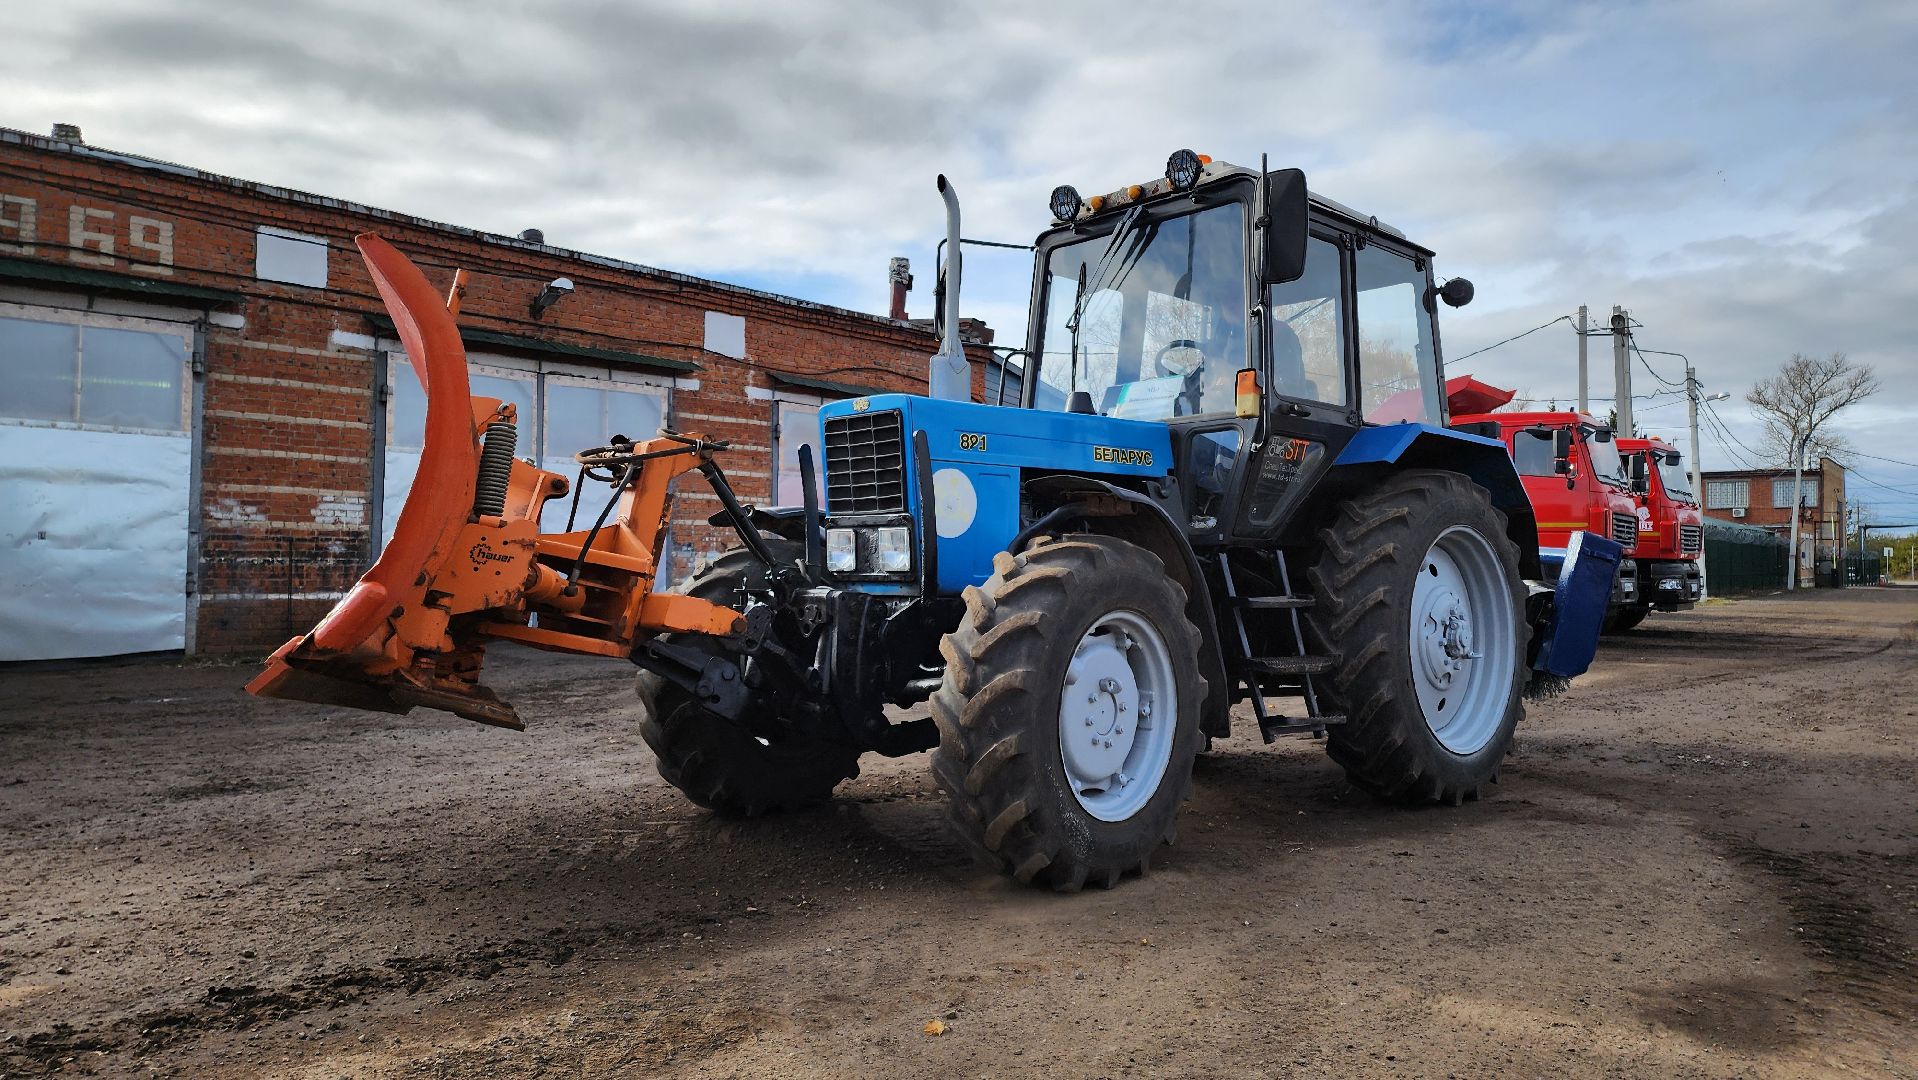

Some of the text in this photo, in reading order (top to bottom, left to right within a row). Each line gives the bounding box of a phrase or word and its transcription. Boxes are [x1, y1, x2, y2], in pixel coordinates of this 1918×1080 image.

[1094, 446, 1153, 466] БЕЛАРУС
[1285, 439, 1310, 460] STT
[476, 547, 515, 563] hauer
